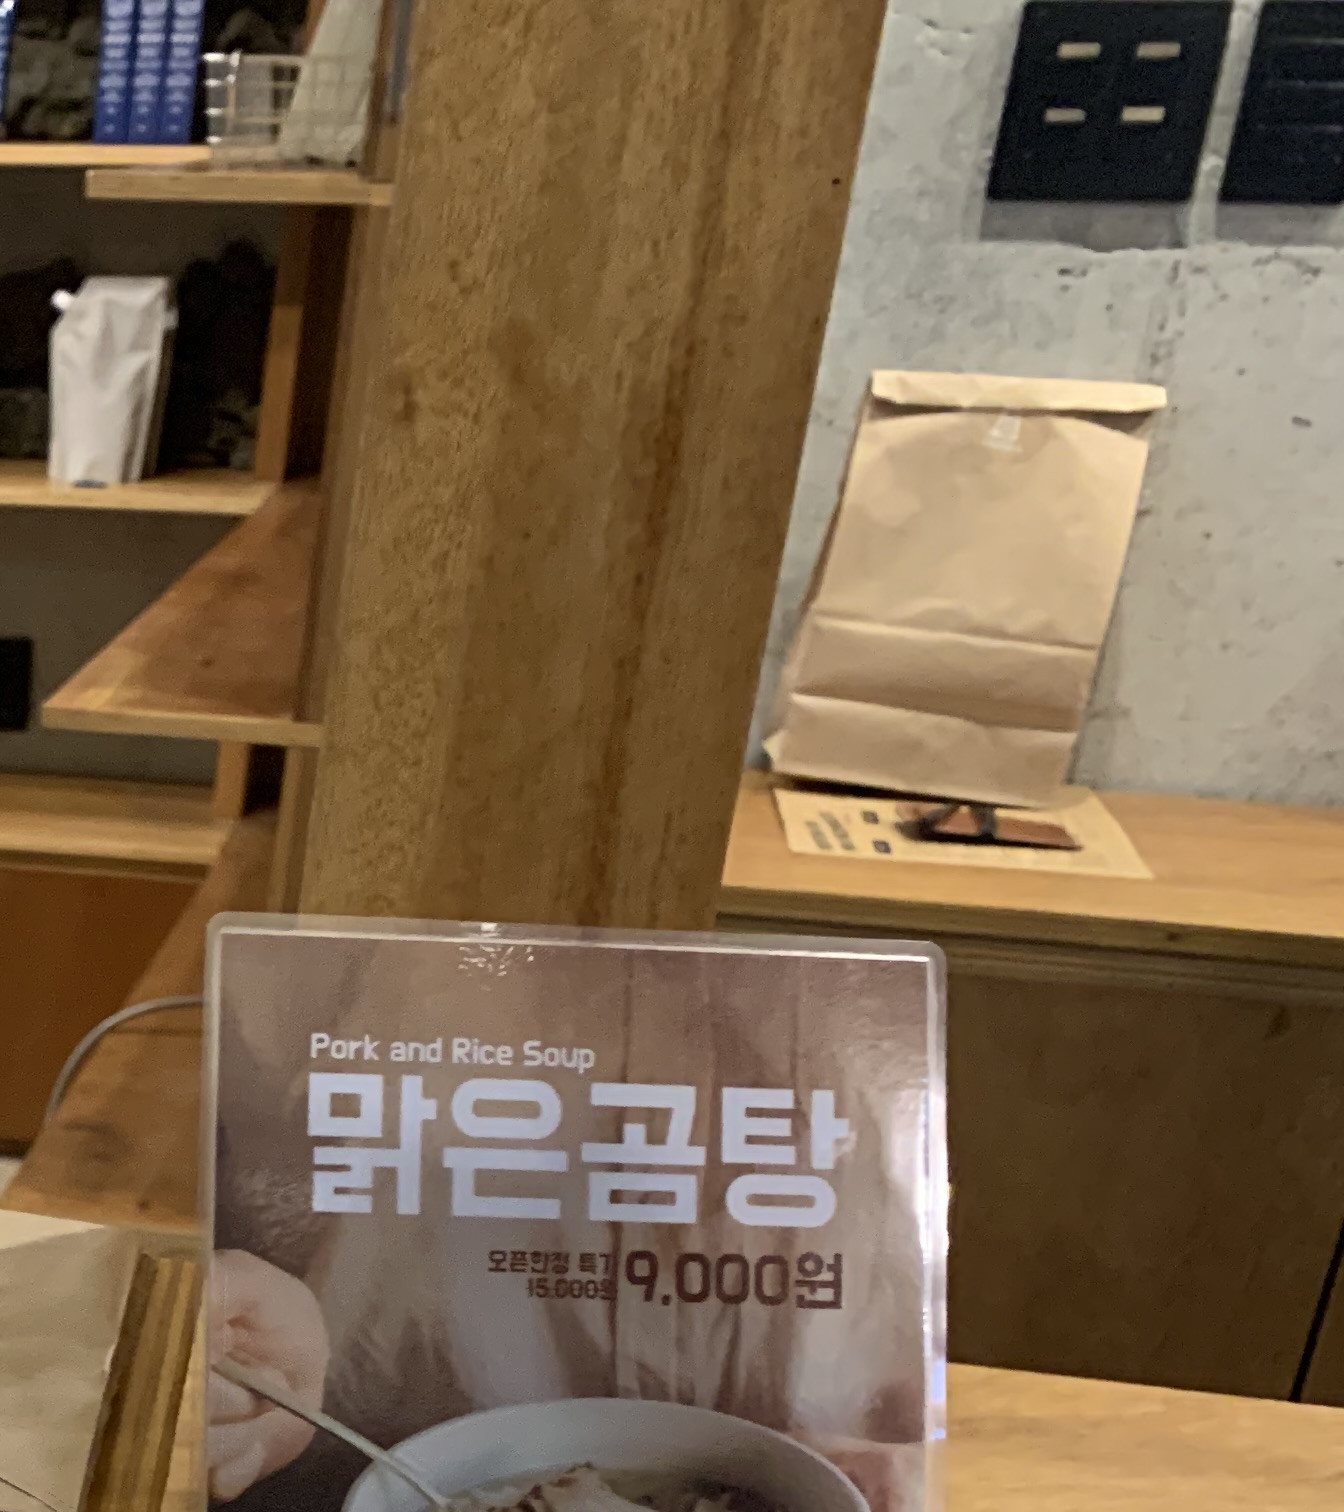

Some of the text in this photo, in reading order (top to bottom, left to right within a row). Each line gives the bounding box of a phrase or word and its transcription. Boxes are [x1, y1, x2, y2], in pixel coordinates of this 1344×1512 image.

[309, 1032, 596, 1074] Pork and Rice Soup
[307, 1071, 856, 1229] 맑은곰탕
[487, 1249, 570, 1275] 오픈한정
